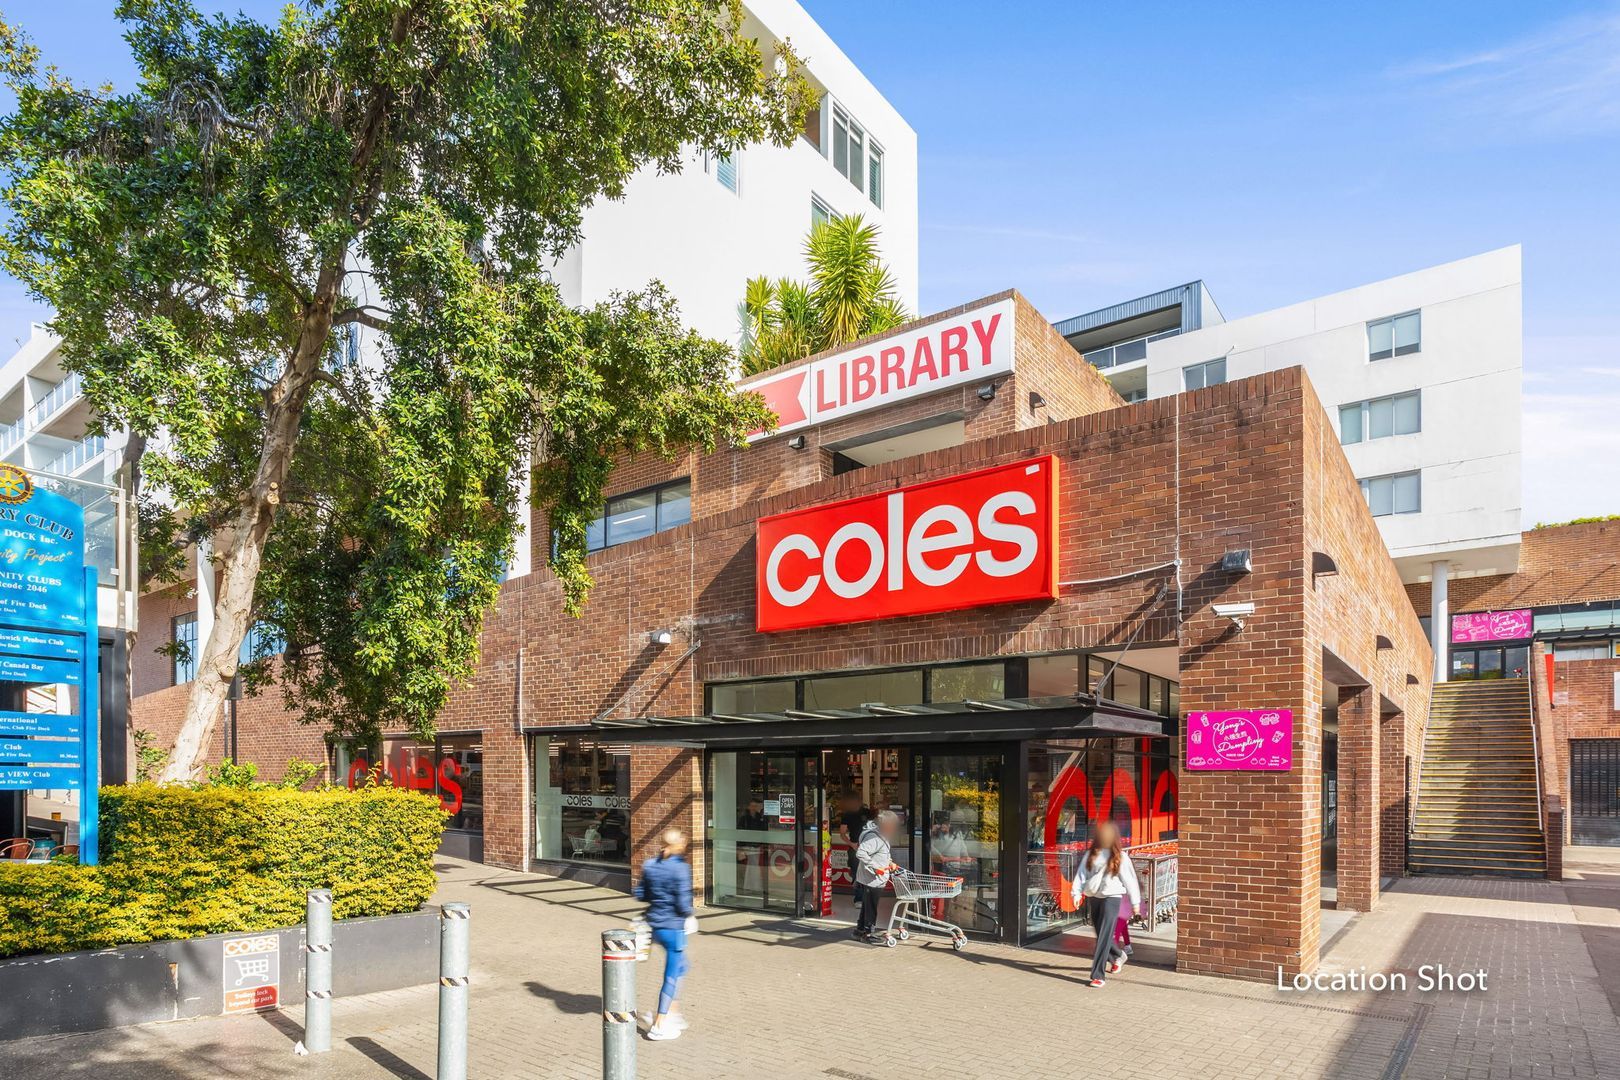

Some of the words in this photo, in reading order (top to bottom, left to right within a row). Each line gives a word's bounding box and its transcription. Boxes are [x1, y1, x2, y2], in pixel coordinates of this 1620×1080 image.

[816, 313, 1002, 413] LIBRARY
[25, 513, 74, 541] CLUB
[4, 529, 36, 541] DOCK
[766, 491, 1039, 607] coles
[27, 574, 62, 587] CLUBS
[27, 584, 48, 593] 2046
[29, 601, 47, 610] Dock
[48, 638, 64, 646] Club
[3, 661, 29, 669] Canada
[31, 663, 44, 671] Bay
[566, 795, 593, 807] coles
[225, 938, 277, 955] coles
[261, 994, 273, 1004] park
